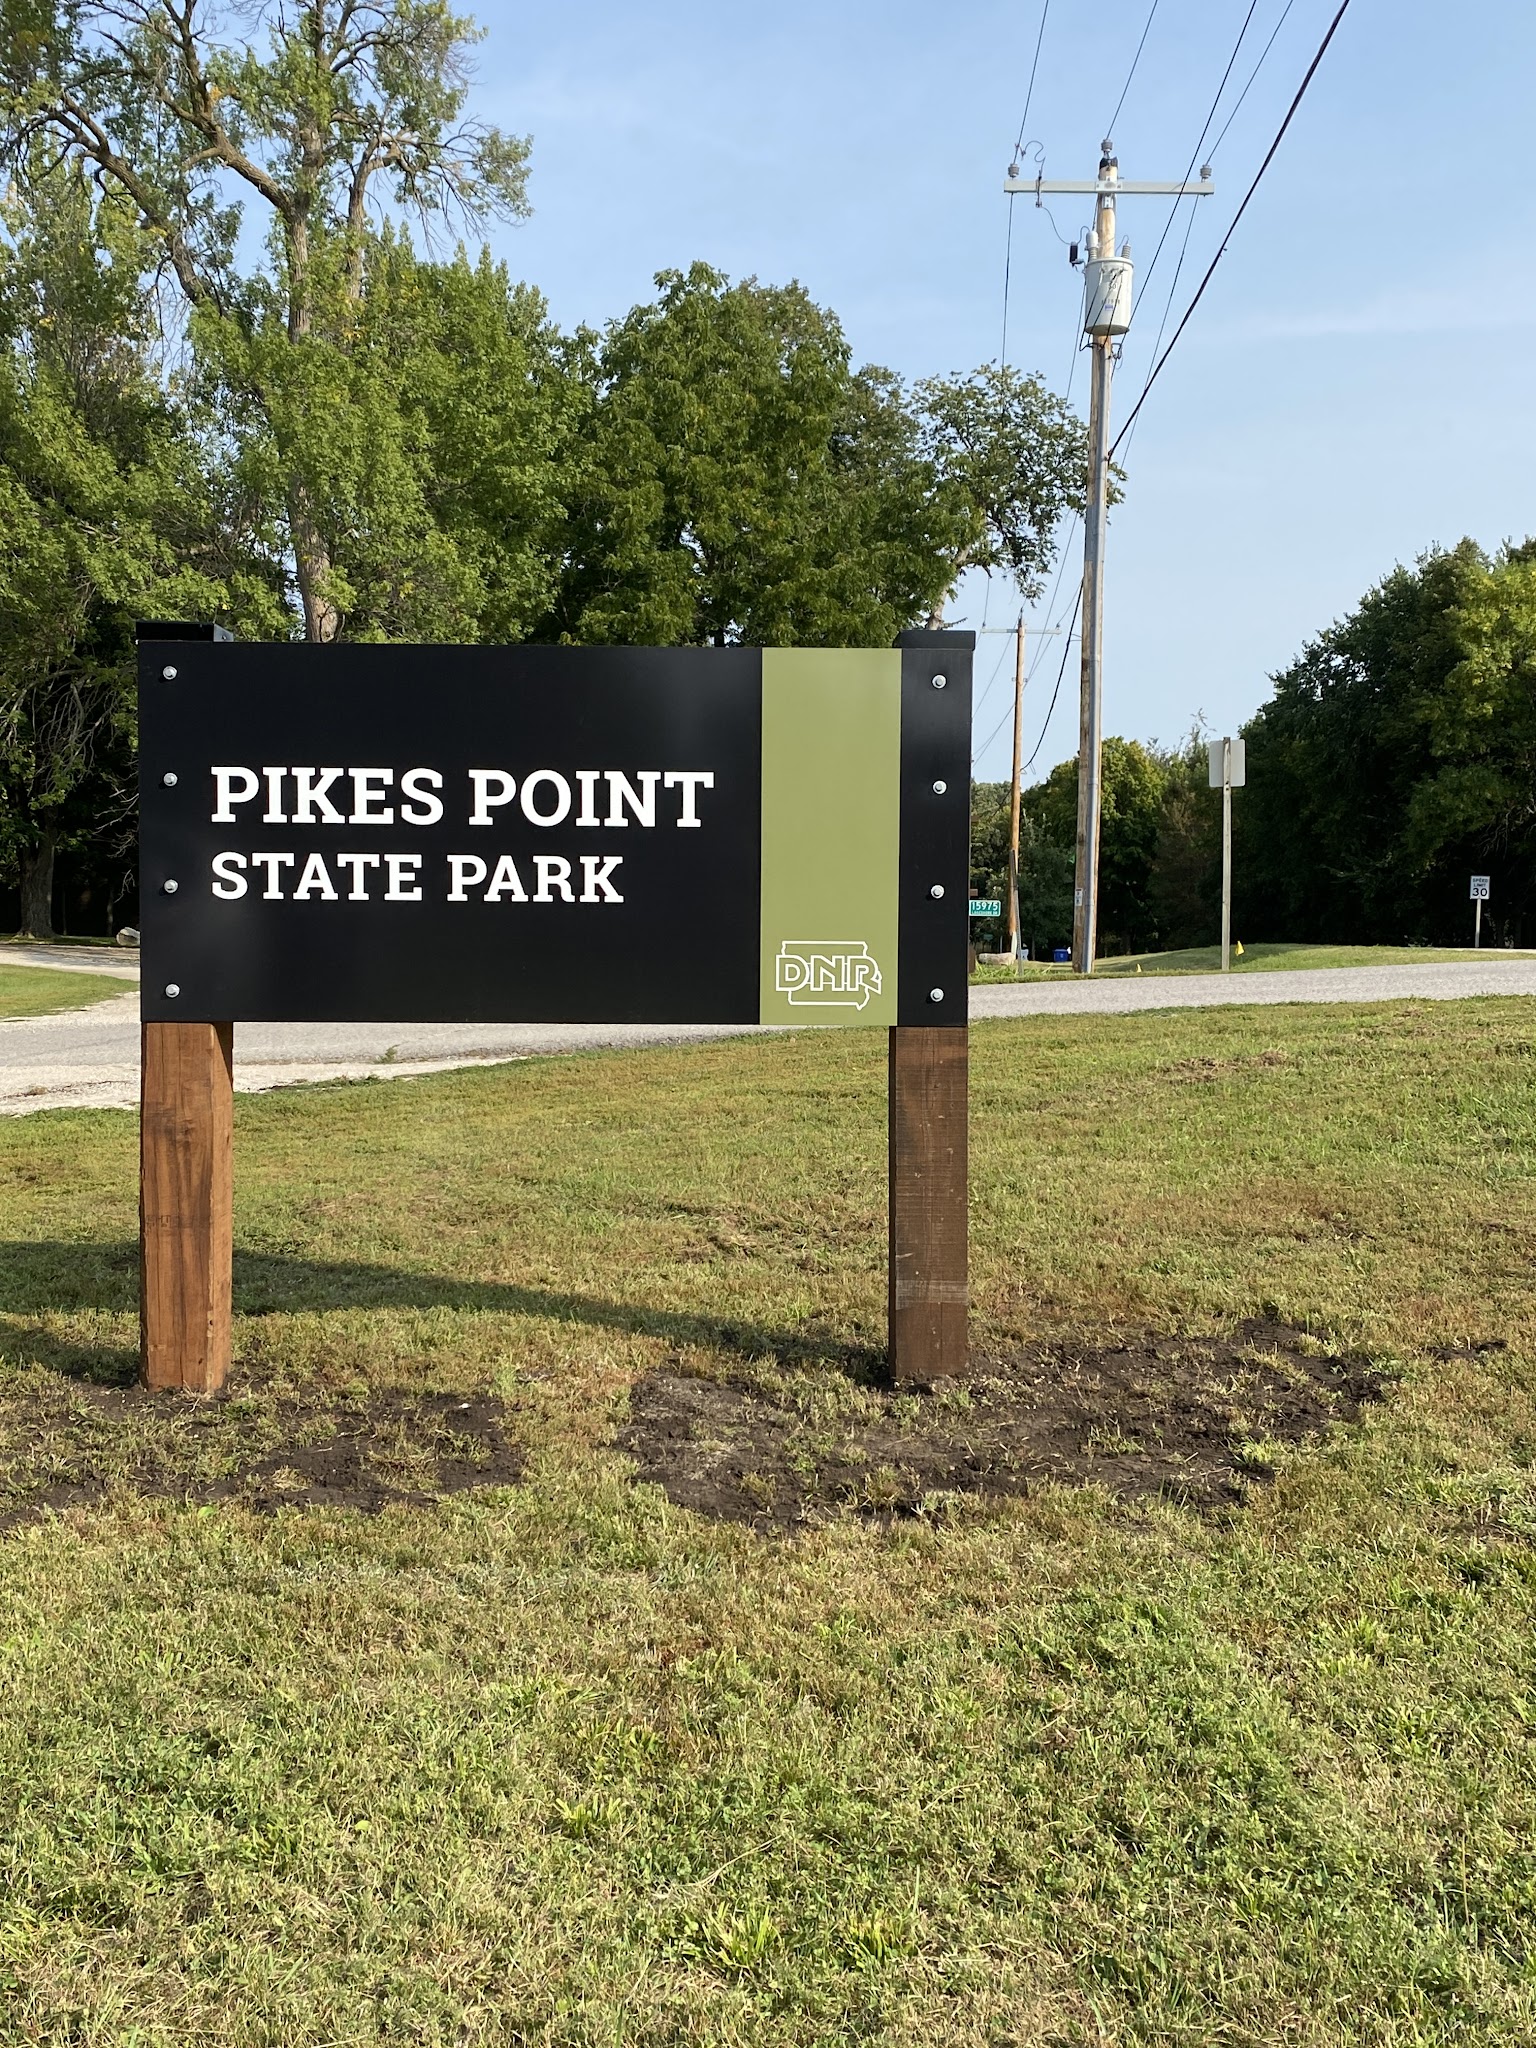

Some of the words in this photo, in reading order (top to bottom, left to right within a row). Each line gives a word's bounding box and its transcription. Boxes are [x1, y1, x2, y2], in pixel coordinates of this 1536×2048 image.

[210, 766, 444, 826] PIKES
[468, 769, 715, 828] POINT
[211, 851, 423, 901] STATE
[446, 854, 624, 903] PARK
[1472, 887, 1488, 897] 30
[971, 901, 998, 911] 15975
[776, 954, 881, 994] DNR
